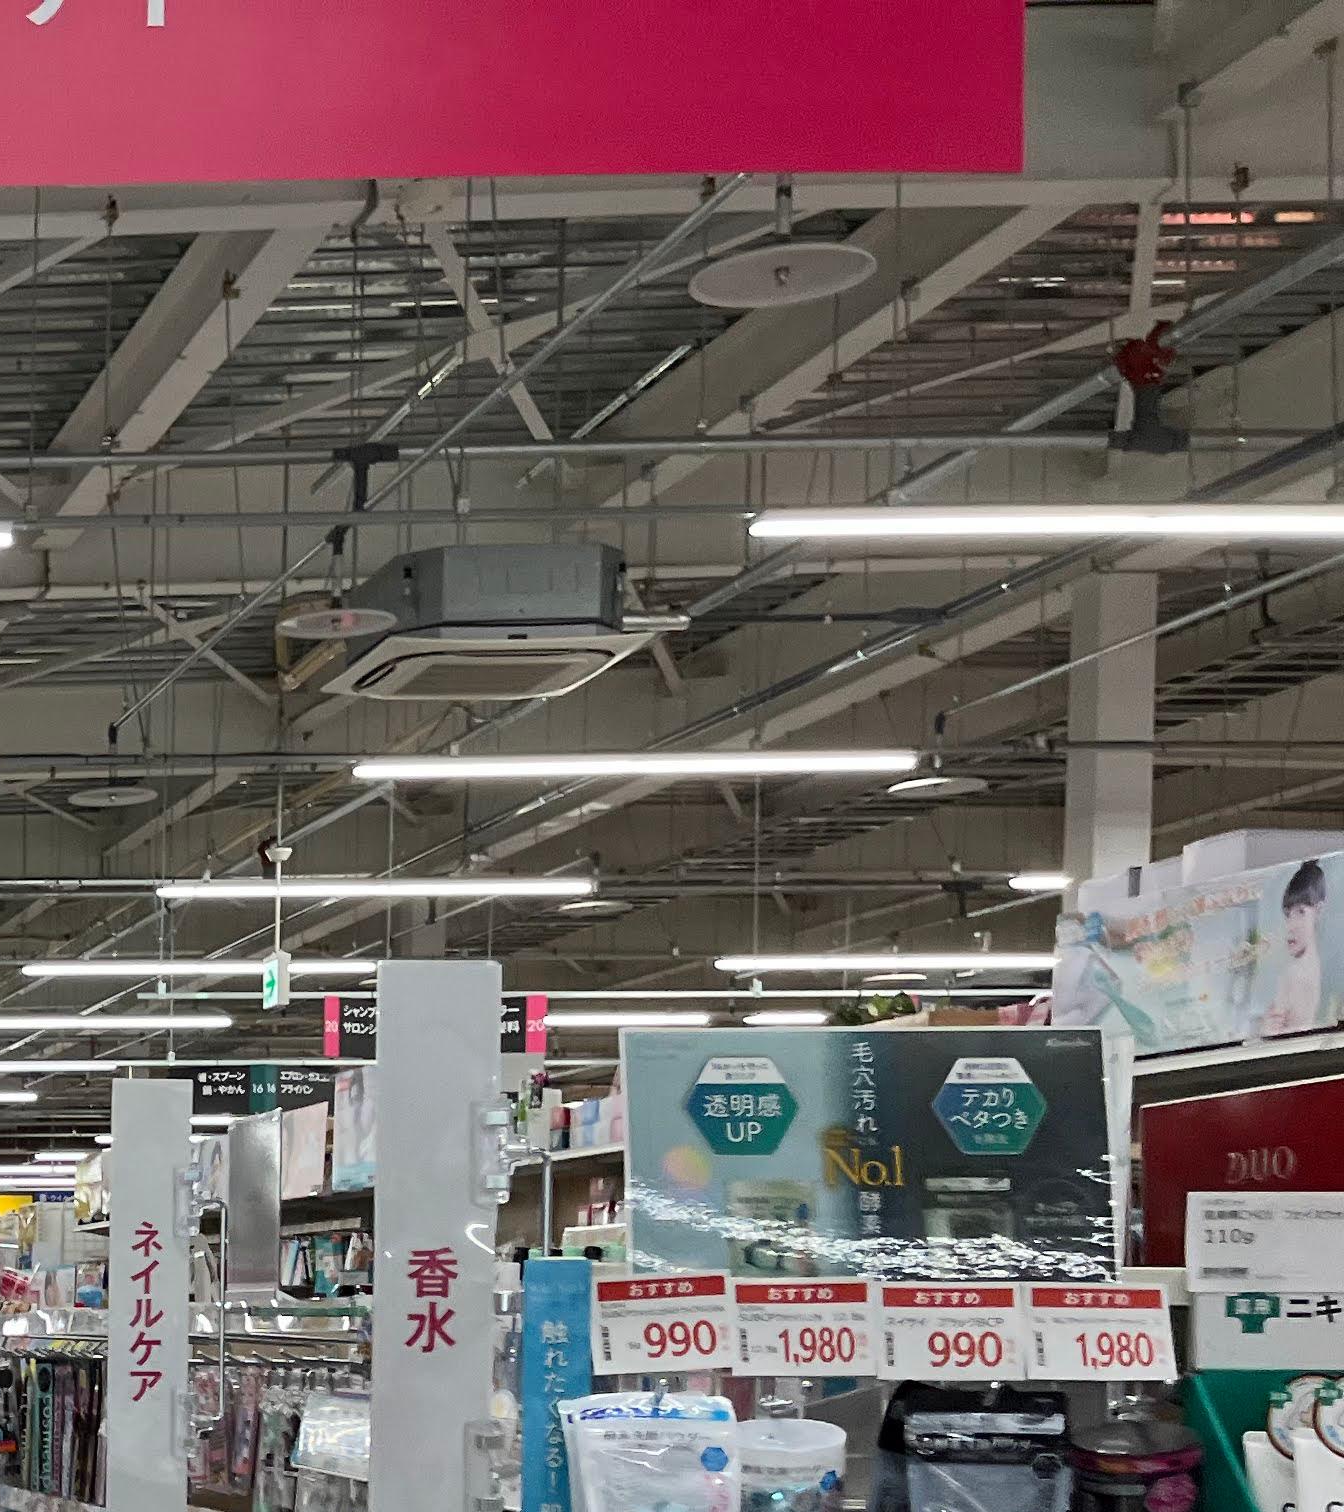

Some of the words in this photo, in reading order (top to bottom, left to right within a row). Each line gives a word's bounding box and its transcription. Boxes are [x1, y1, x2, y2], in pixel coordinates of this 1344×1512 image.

[324, 1020, 339, 1032] 20
[252, 1083, 263, 1094] 16
[851, 1041, 879, 1134] 毛穴汚れ
[960, 1087, 1015, 1108] テカリ
[702, 1093, 782, 1119] 透明感
[726, 1121, 763, 1144] UP
[1226, 1146, 1297, 1185] DUO
[405, 1246, 460, 1355] 香水
[627, 1280, 694, 1298] おすすめ
[767, 1287, 834, 1303] おすすめ
[914, 1291, 980, 1306] おすすめ
[1063, 1291, 1131, 1307] おすすめ
[128, 1220, 163, 1403] ネイルケア
[644, 1320, 718, 1359] 990
[778, 1326, 857, 1367] 1,980
[927, 1330, 1004, 1368] 990
[1075, 1331, 1155, 1369] 1,980
